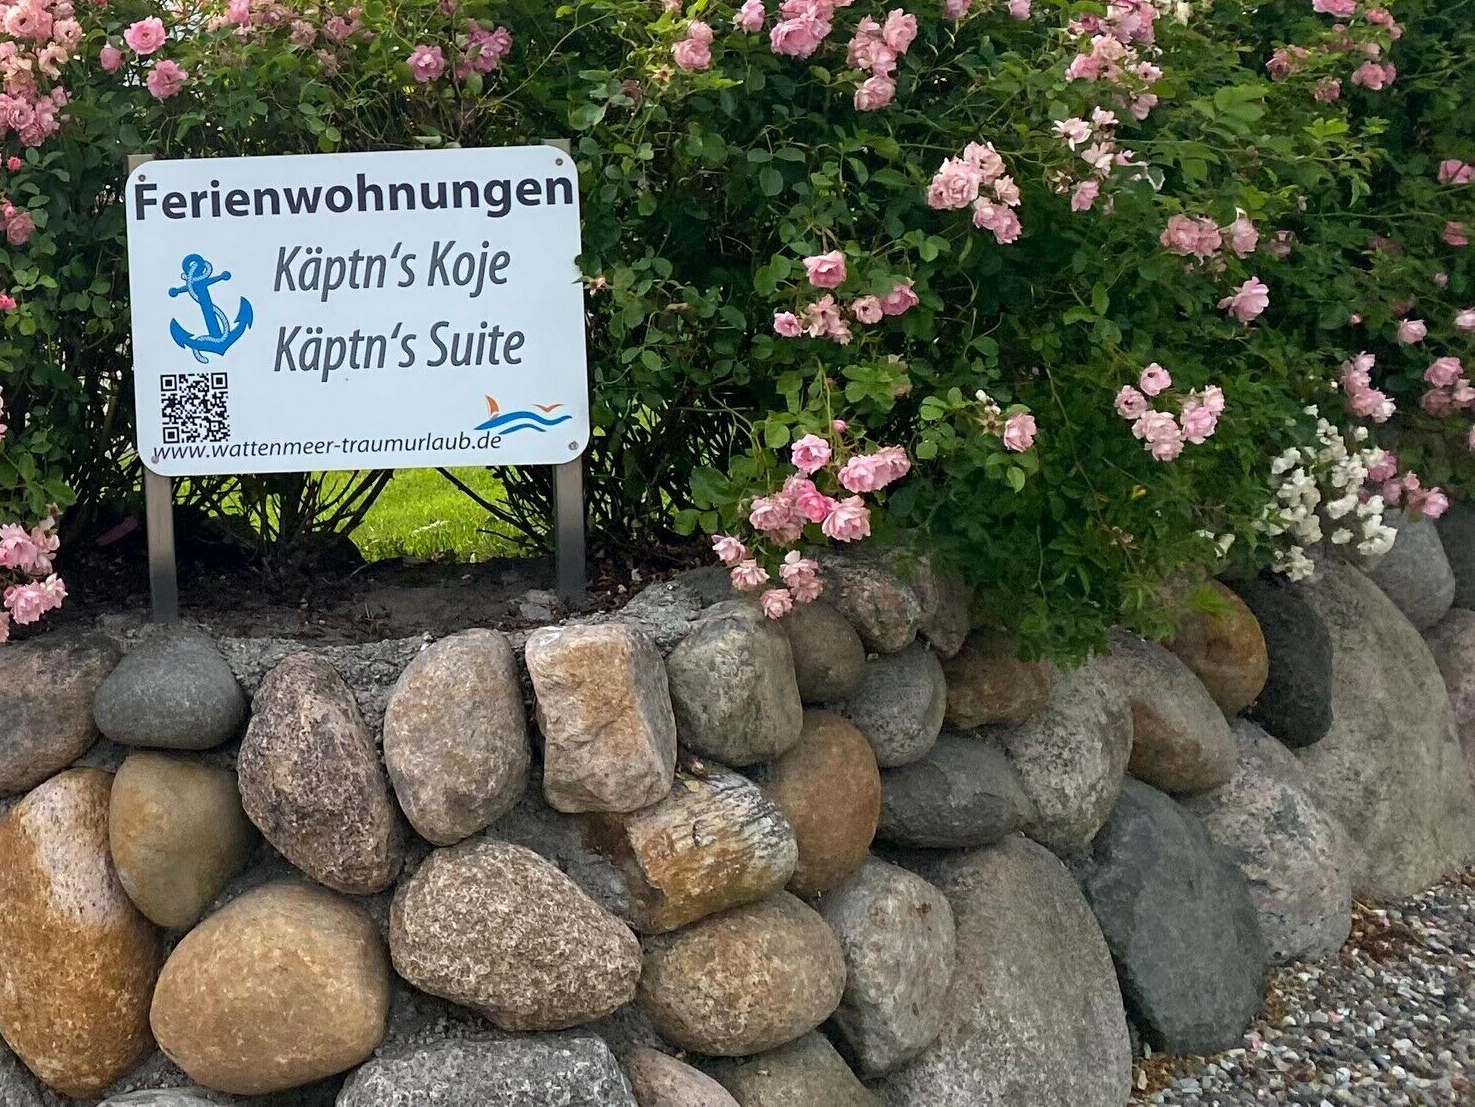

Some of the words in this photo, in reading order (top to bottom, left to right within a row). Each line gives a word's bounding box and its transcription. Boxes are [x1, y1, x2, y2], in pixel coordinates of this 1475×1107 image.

[134, 173, 574, 221] Ferienwohnungen
[427, 240, 511, 298] Koje
[426, 321, 525, 368] Suite
[153, 431, 502, 462] www.wattenmeer-traumurlaub.de
